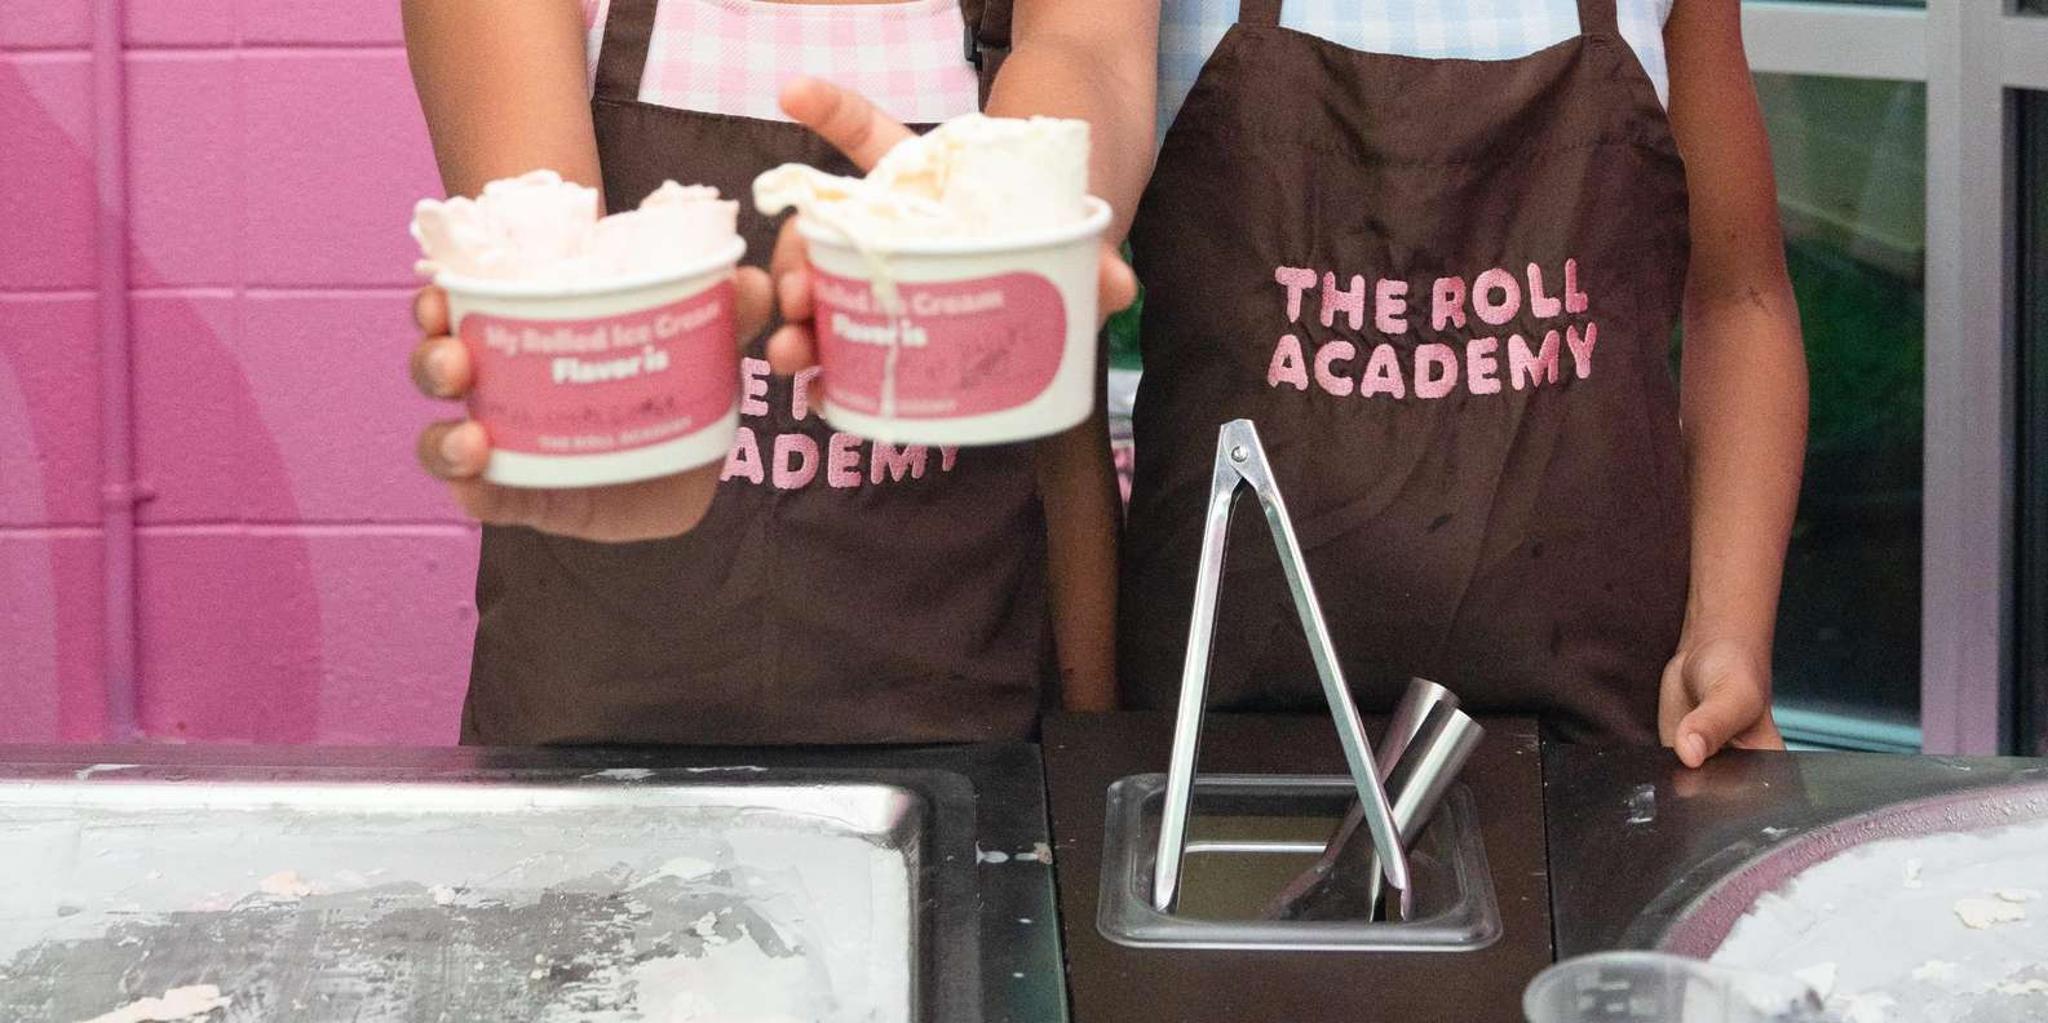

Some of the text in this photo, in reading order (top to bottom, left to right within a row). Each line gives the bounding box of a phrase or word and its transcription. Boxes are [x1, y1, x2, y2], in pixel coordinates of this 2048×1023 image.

[1274, 257, 1589, 334] THE ROLL
[553, 344, 670, 384] Flavor is
[1267, 321, 1598, 399] ACADEMY
[719, 426, 959, 490] ADEMY
